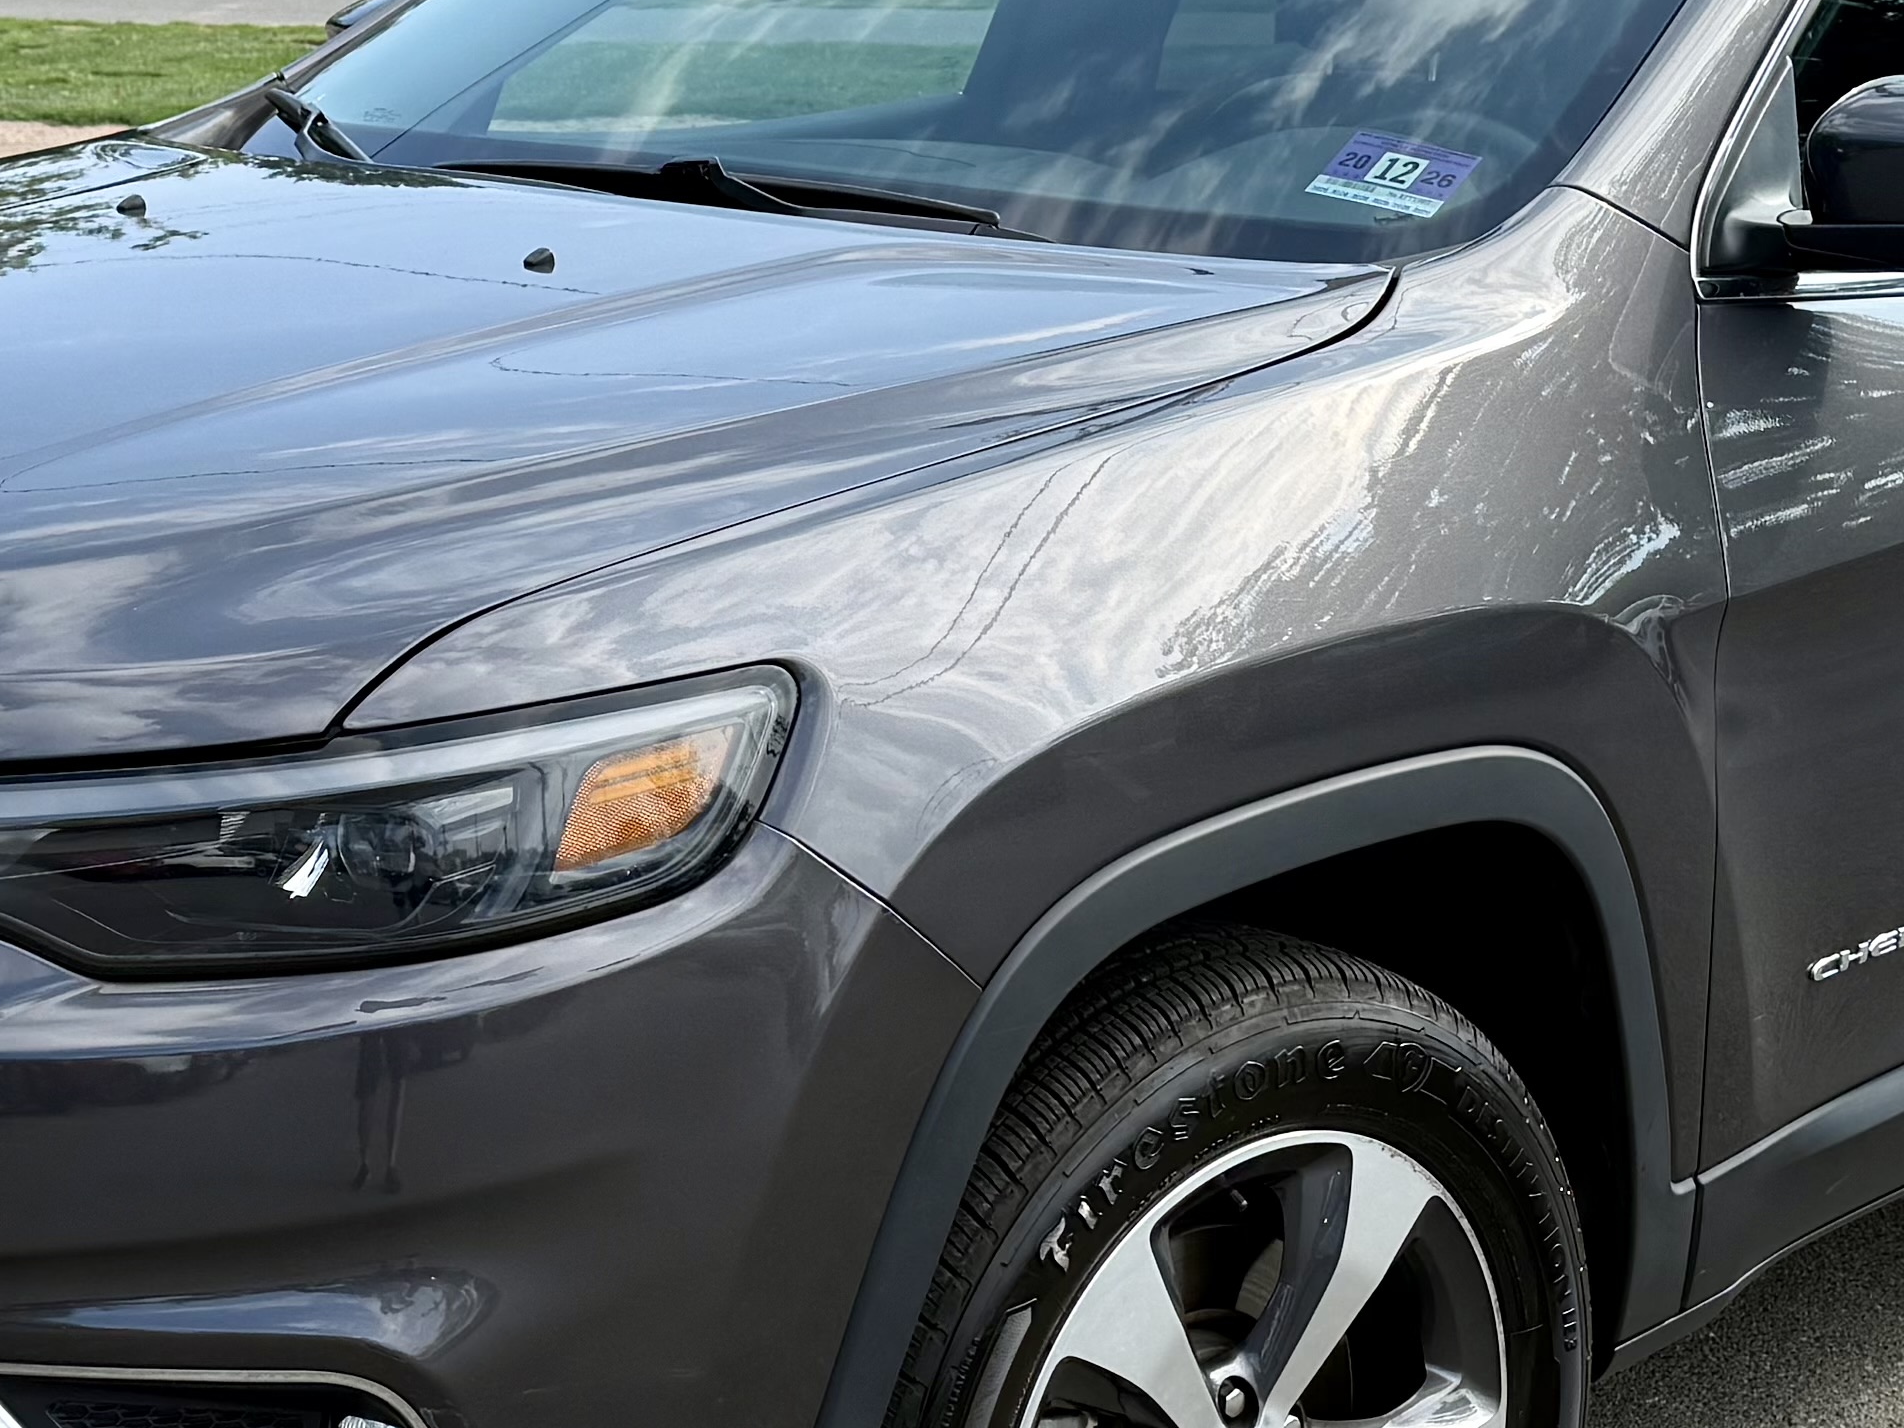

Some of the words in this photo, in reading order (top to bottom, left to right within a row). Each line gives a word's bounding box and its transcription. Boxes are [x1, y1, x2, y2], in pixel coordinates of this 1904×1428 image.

[1338, 152, 1372, 170] 20
[1374, 157, 1420, 185] 12
[1420, 171, 1457, 189] 26
[1035, 1036, 1348, 1275] Firestone
